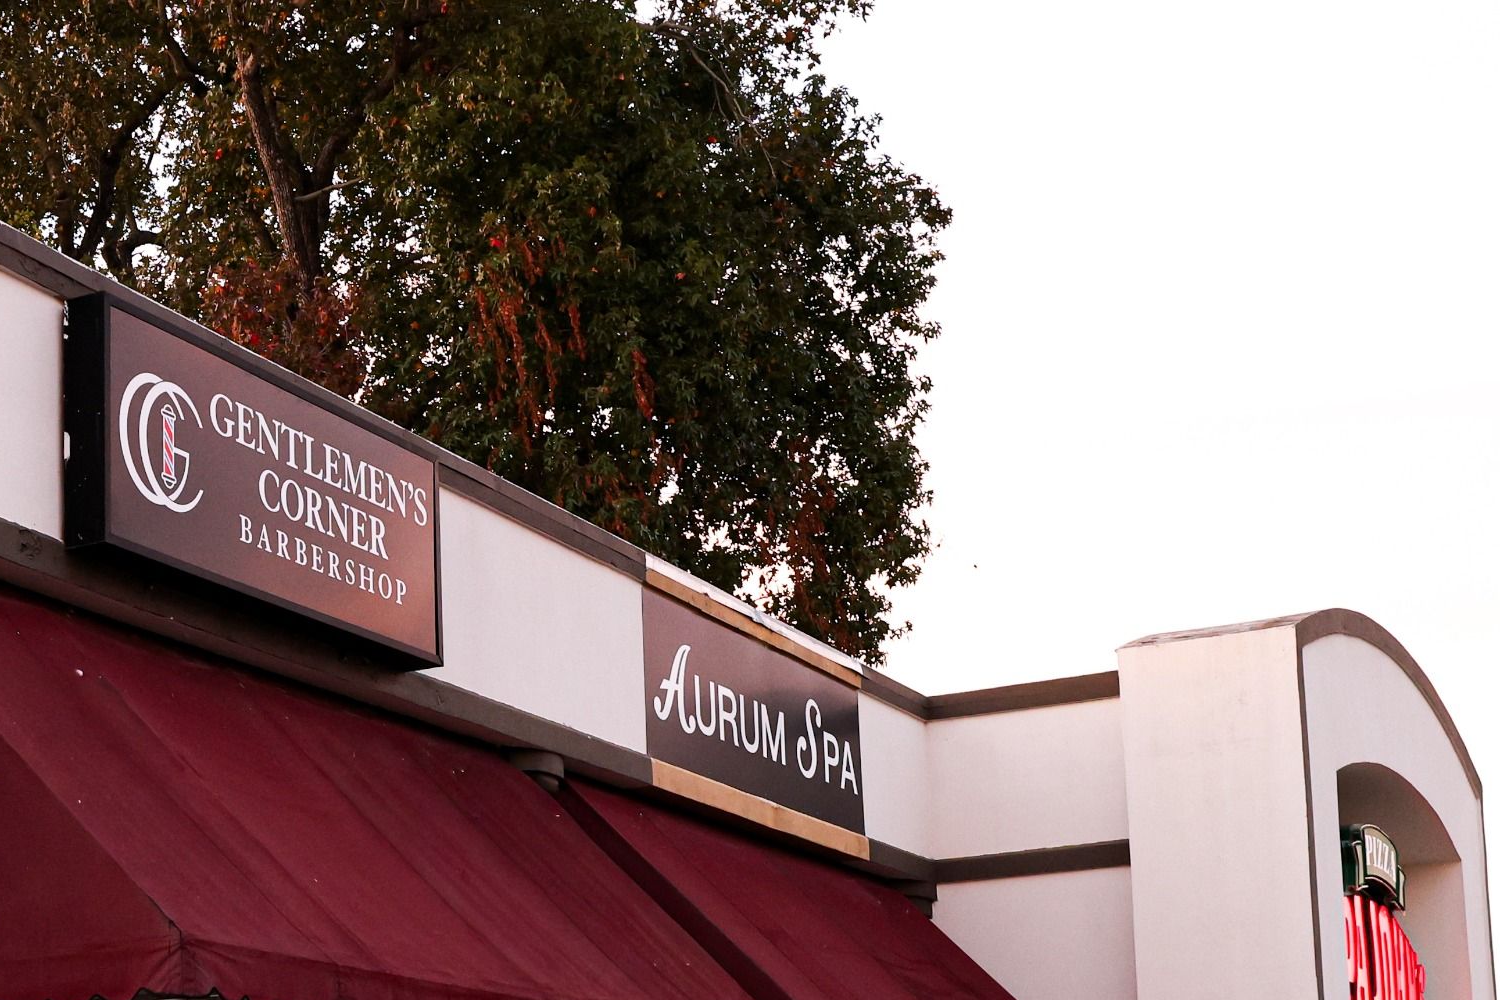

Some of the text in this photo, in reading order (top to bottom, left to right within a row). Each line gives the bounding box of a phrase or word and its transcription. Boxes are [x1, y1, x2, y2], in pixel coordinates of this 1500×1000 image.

[209, 392, 428, 527] GENTLEMEN'S
[239, 514, 407, 606] BARBERSHOP
[258, 469, 389, 561] CORNER
[1365, 834, 1397, 881] PIZZA
